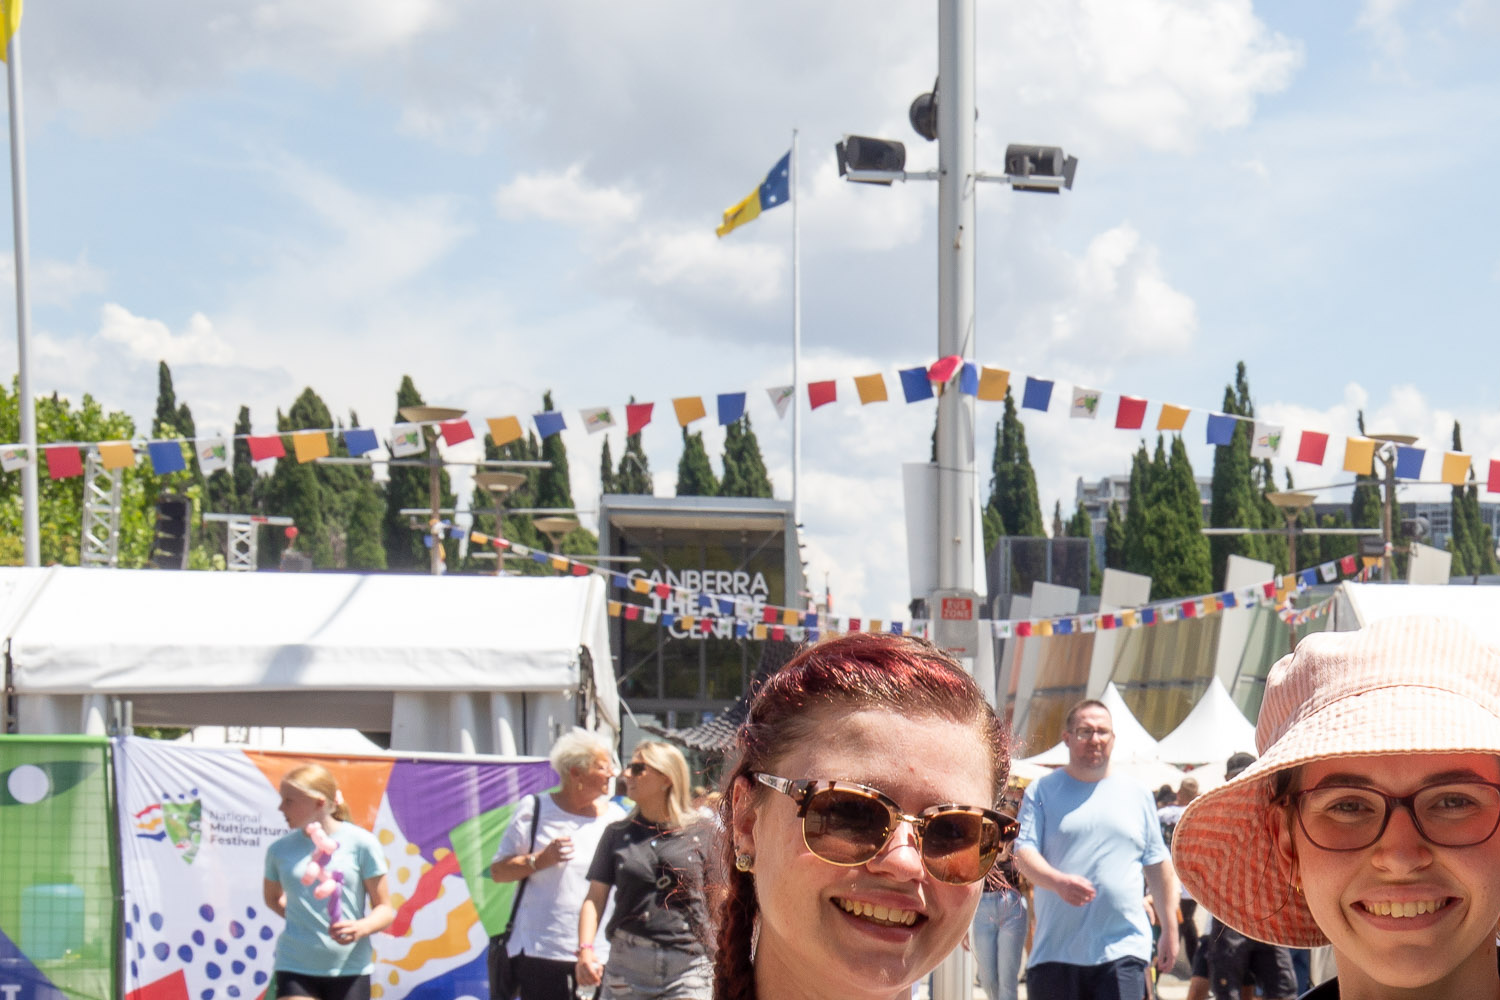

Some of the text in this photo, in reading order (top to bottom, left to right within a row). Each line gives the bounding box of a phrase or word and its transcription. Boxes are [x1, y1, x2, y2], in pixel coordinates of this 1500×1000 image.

[626, 568, 769, 595] CANBERRA
[210, 811, 261, 824] National
[210, 834, 260, 847] Festival
